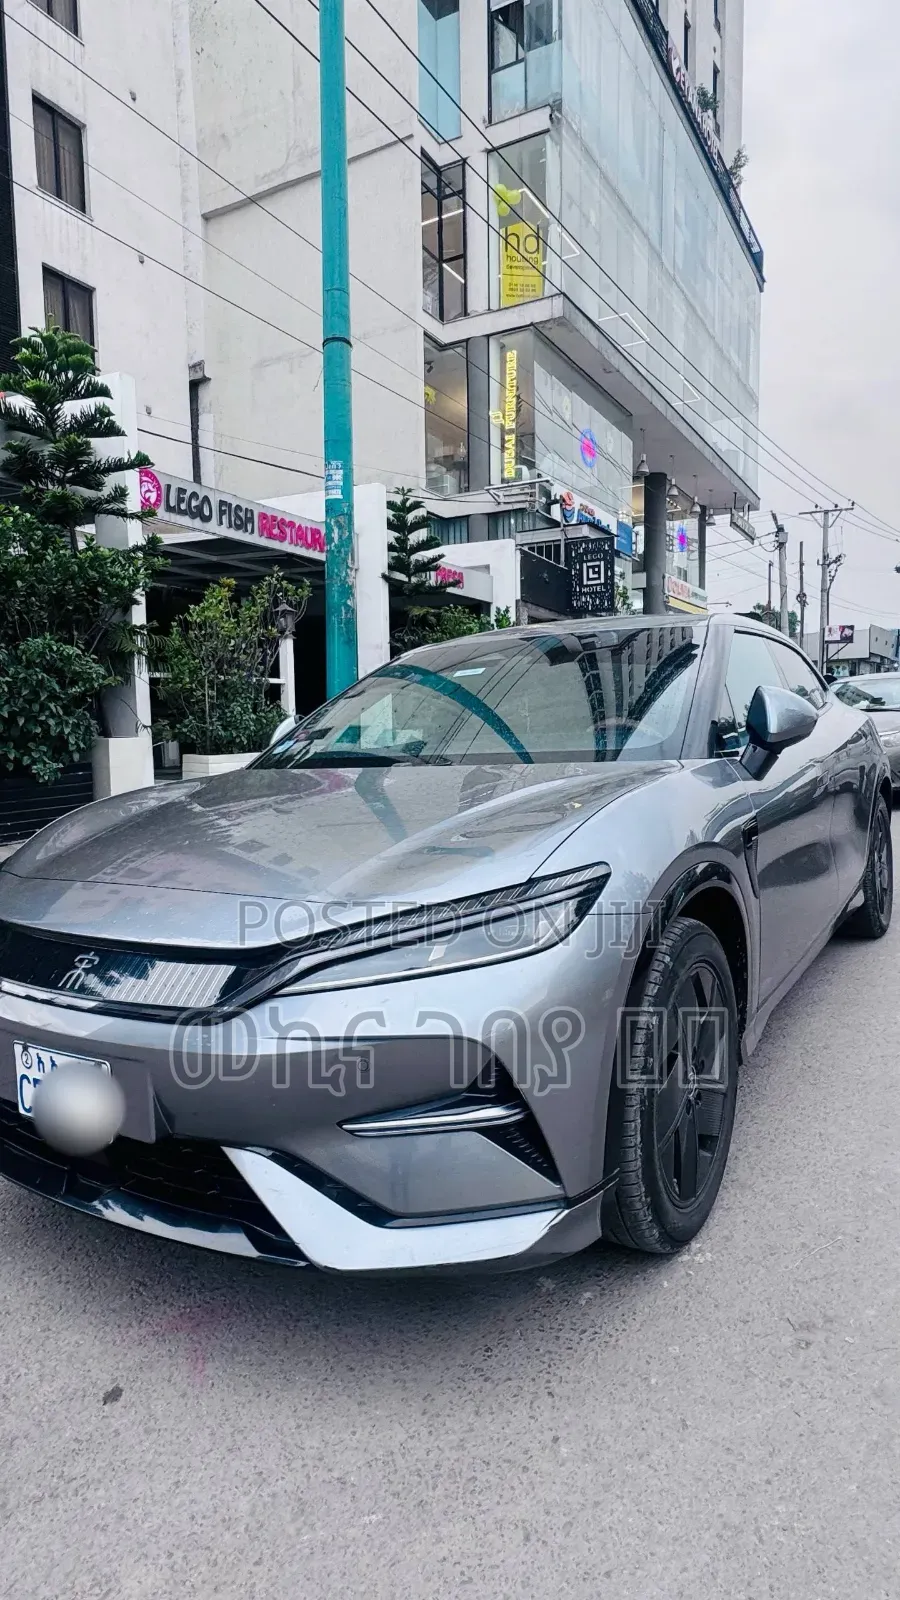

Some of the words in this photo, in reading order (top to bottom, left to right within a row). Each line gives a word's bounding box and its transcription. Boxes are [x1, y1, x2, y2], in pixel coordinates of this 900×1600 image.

[505, 350, 517, 429] FURNITURE
[504, 433, 517, 478] DUBAI
[164, 483, 213, 523] LEGO
[217, 499, 255, 535] FISH
[583, 552, 604, 561] LEGO
[581, 585, 606, 593] HOTEL
